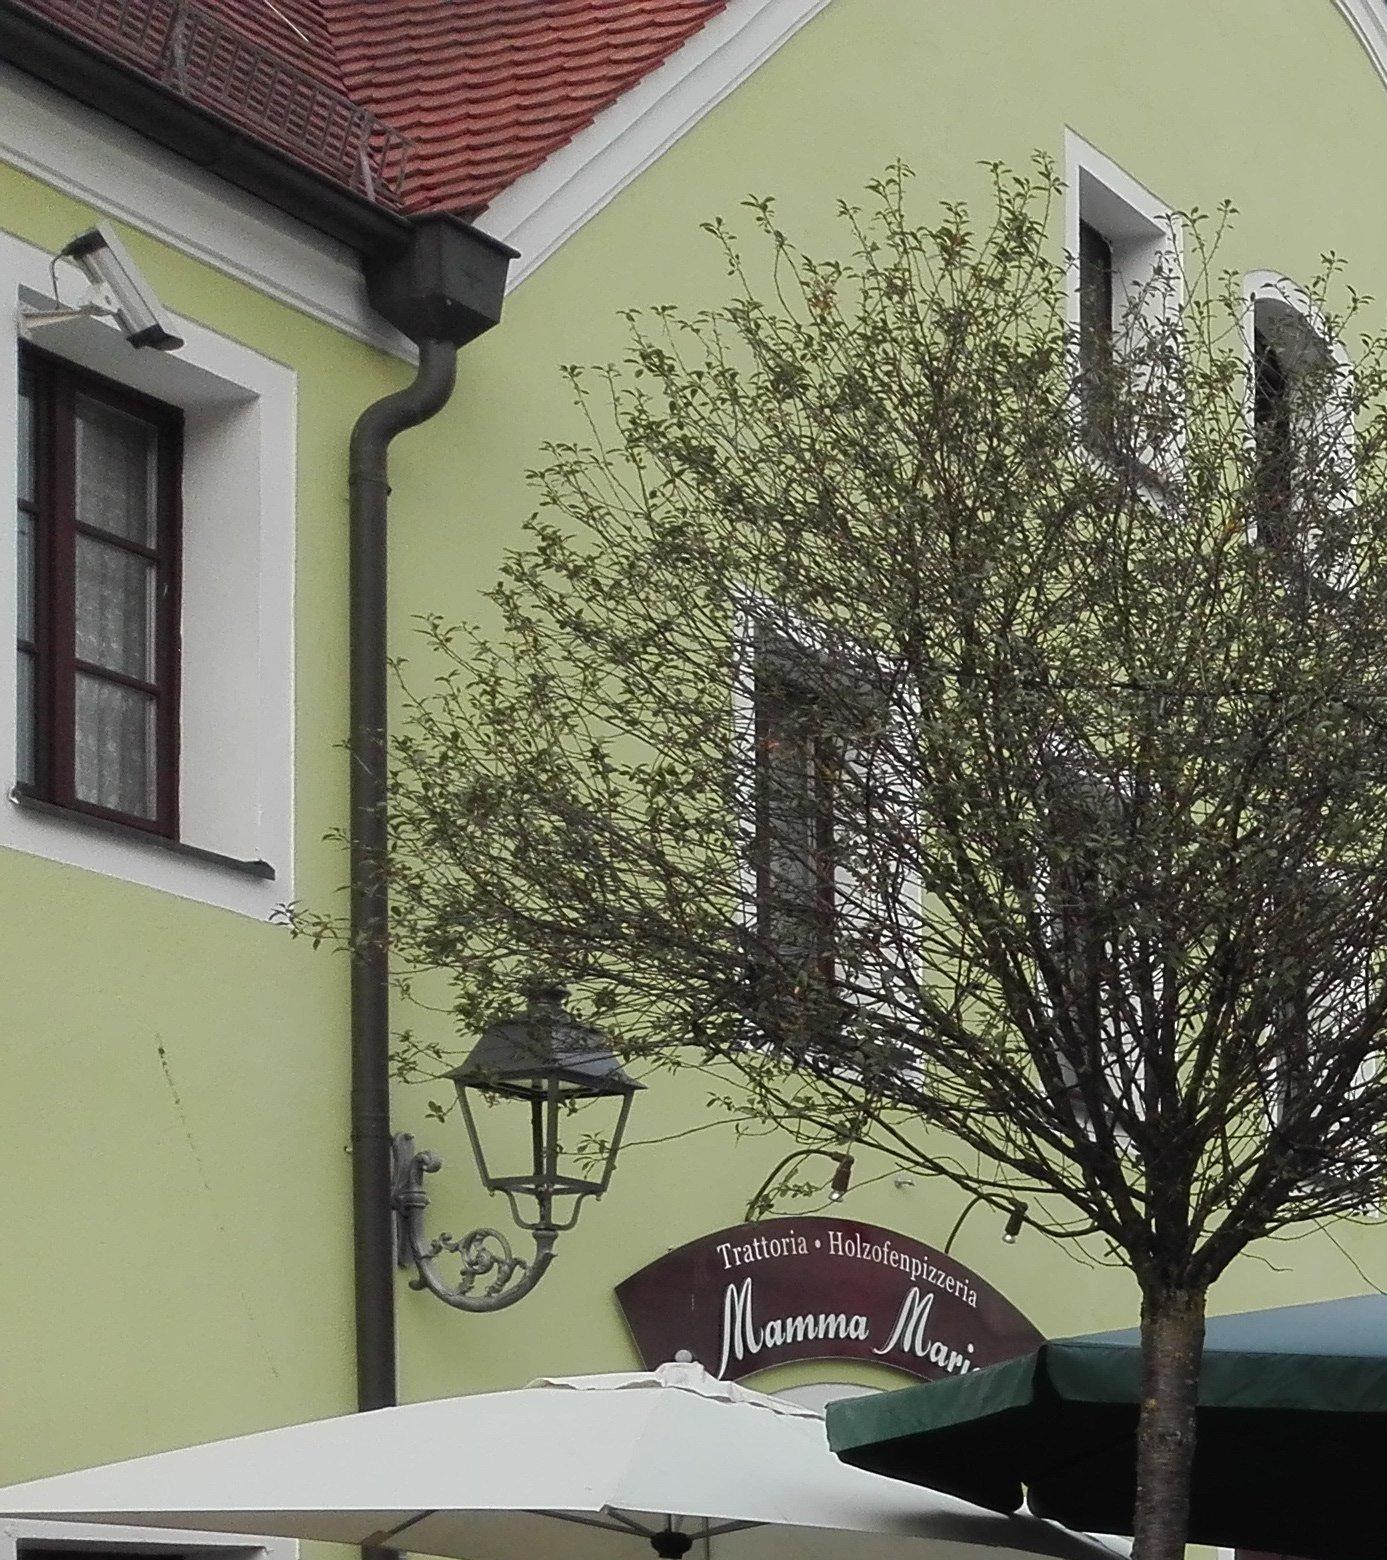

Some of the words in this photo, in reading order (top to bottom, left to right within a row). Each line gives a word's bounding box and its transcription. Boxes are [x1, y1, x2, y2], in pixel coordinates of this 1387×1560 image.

[717, 1232, 809, 1270] Trattoria
[828, 1230, 979, 1308] Holzofenpizzeria
[718, 1277, 869, 1381] Mamma
